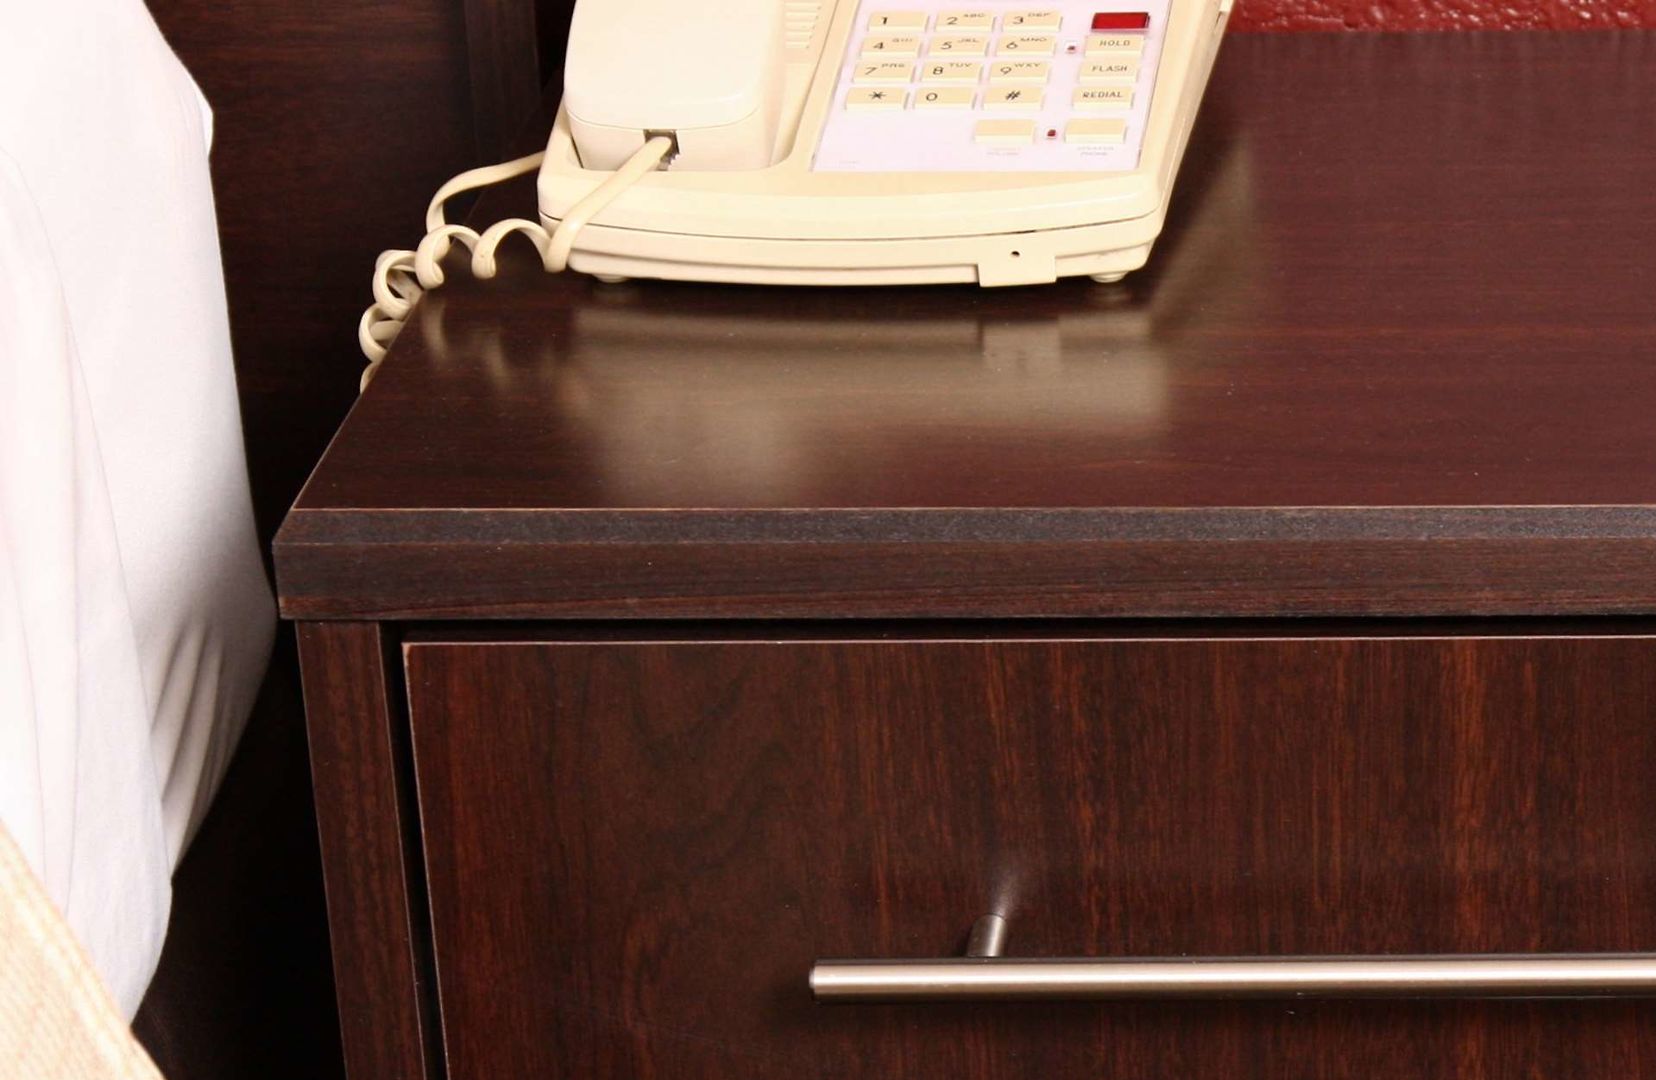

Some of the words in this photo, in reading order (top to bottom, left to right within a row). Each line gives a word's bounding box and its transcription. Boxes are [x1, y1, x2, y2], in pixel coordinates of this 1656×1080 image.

[881, 16, 889, 25] 1
[946, 16, 958, 25] 2
[1012, 16, 1024, 25] 3
[873, 41, 885, 50] 4
[941, 41, 953, 50] 5
[1006, 41, 1018, 50] 6
[1099, 39, 1131, 47] HOLD
[865, 66, 877, 75] 7
[932, 66, 944, 75] 8
[1000, 66, 1012, 75] 9
[925, 92, 938, 101] 0
[1082, 90, 1123, 98] REDIAL
